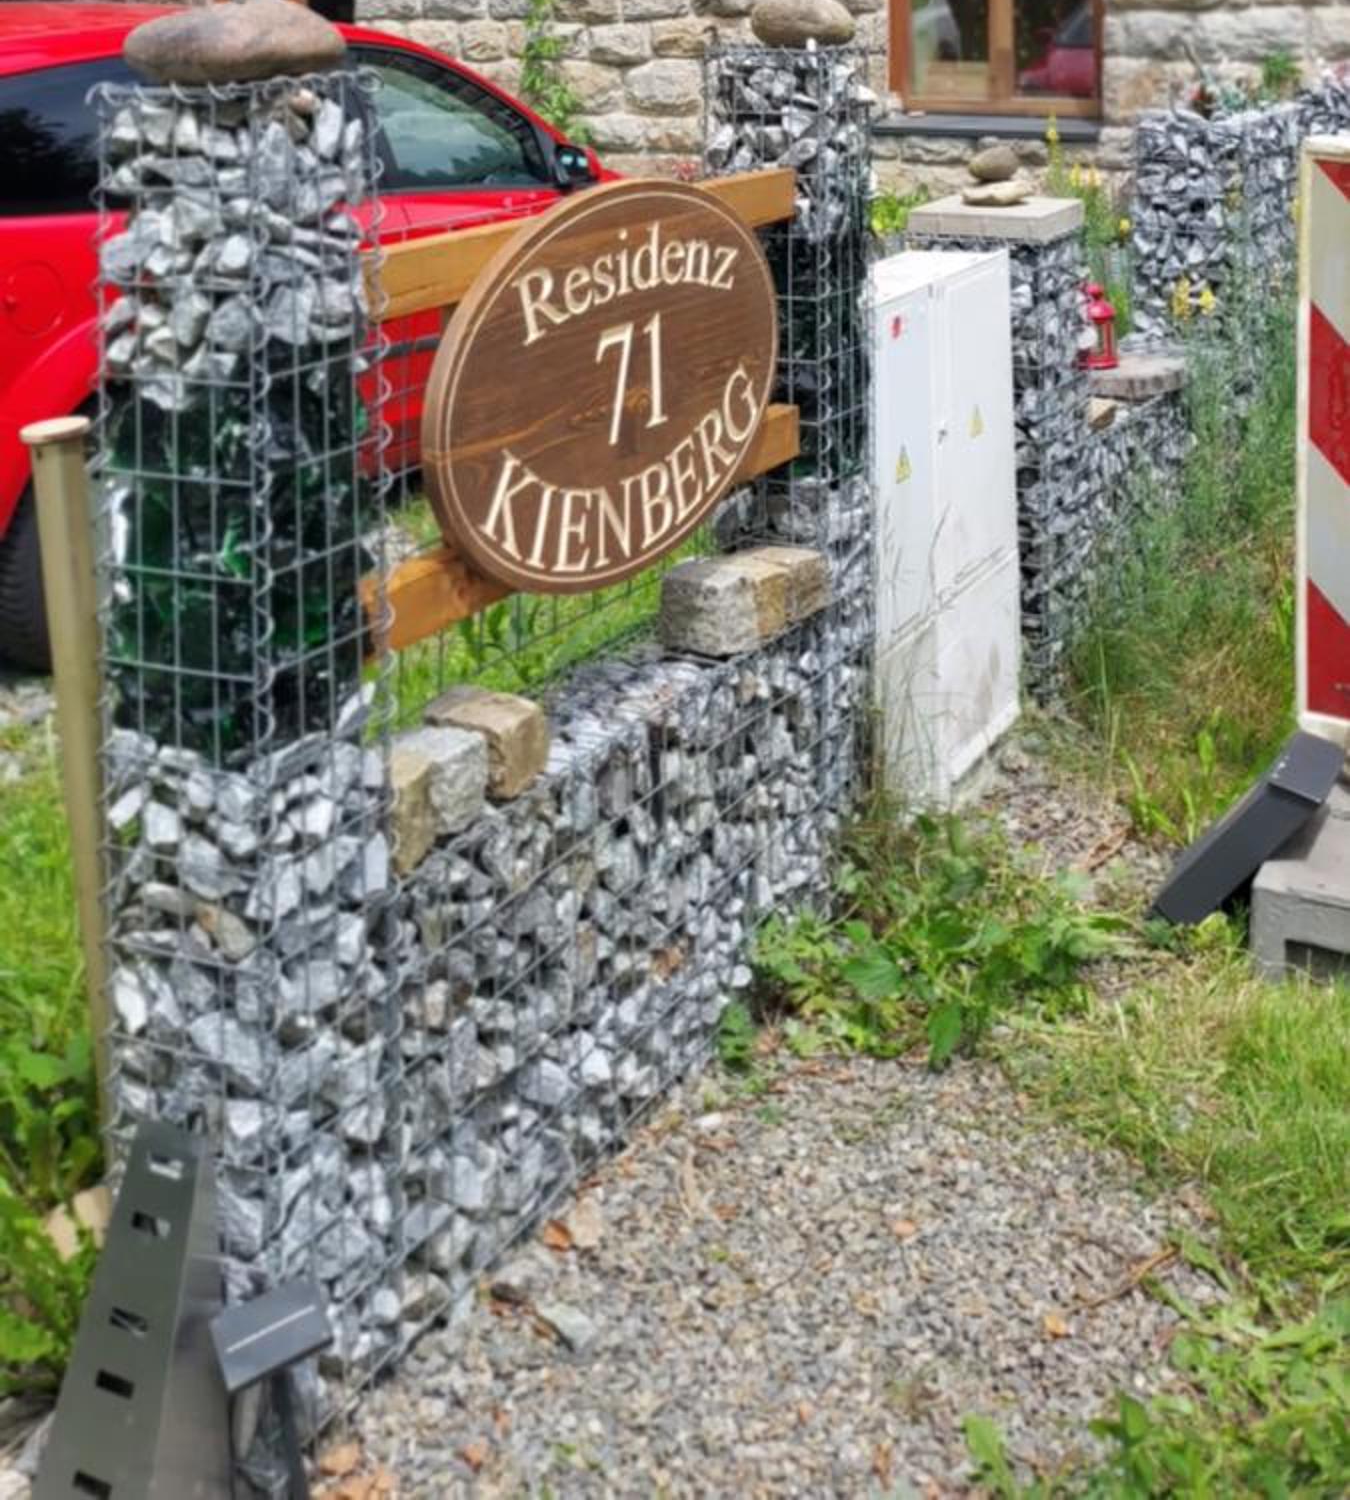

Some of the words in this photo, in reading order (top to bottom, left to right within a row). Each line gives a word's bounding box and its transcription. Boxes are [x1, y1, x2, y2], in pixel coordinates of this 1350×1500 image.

[513, 221, 738, 347] Residenz
[596, 312, 668, 446] 71
[479, 366, 759, 573] KIENBERG
